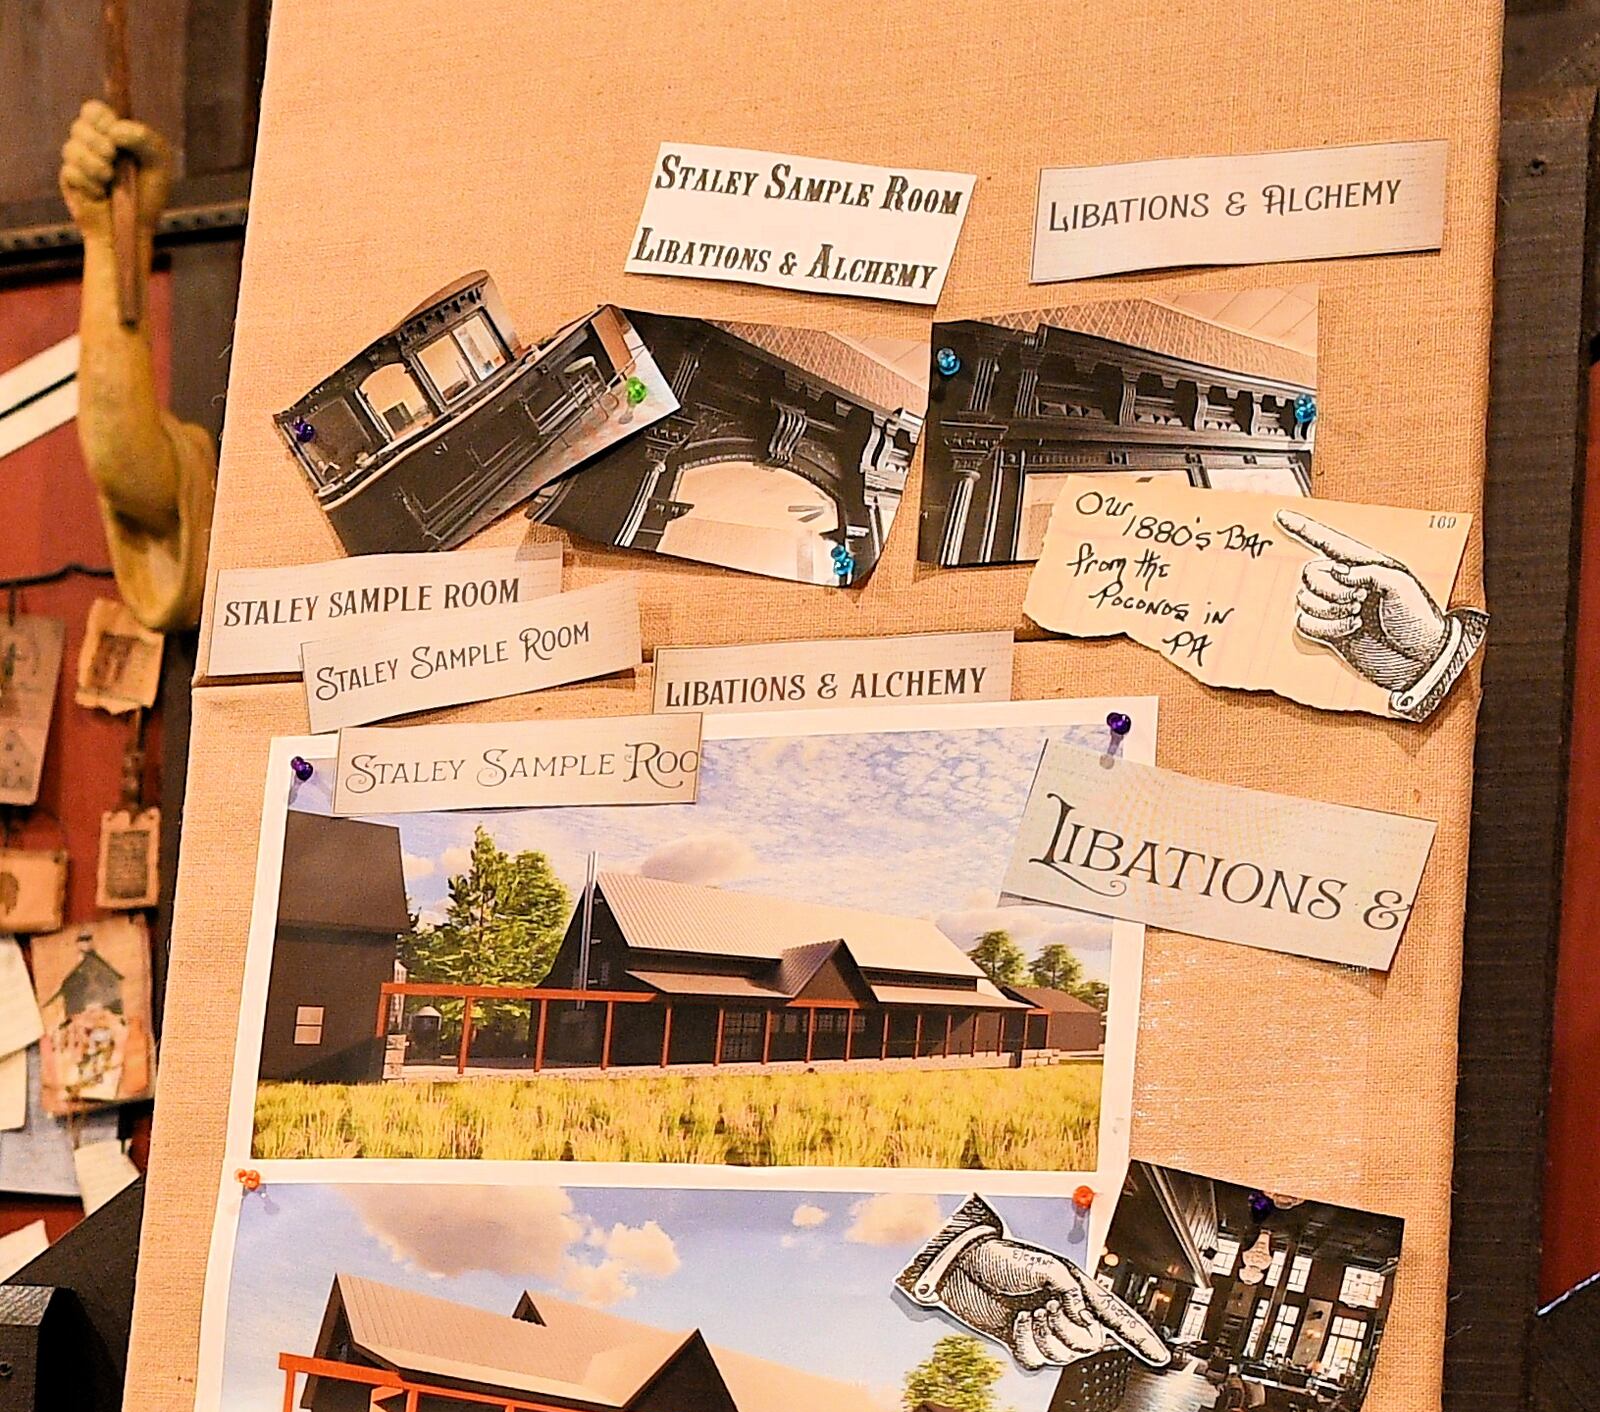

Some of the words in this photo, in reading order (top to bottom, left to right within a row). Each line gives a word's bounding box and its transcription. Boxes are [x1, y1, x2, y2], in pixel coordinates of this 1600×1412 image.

[654, 153, 760, 197] STALEY
[763, 162, 875, 208] SAMPLE
[879, 174, 964, 216] ROOM
[1048, 192, 1210, 233] LIBATIONS
[1225, 190, 1246, 217] &
[1261, 178, 1403, 217] ALCHEMY
[631, 227, 772, 274] LIBATIONS
[778, 250, 797, 276] &
[804, 242, 939, 290] ALCHEMY
[1076, 491, 1134, 519] Our
[1123, 514, 1212, 551] 1880's
[1066, 542, 1128, 580] from
[1133, 548, 1170, 591] the
[223, 595, 319, 628] STALEY
[328, 584, 433, 619] SAMPLE
[443, 577, 521, 610] ROOM
[315, 657, 399, 702] STALEY
[410, 639, 509, 680] SAMPLE
[518, 621, 591, 663] ROOM
[1161, 631, 1213, 668] PA
[665, 674, 807, 708] LIBATIONS
[816, 672, 839, 701] &
[849, 666, 988, 700] ALCHEMY
[344, 752, 466, 796] STALEY
[475, 747, 616, 788] SAMPLE
[1028, 792, 1349, 921] LIBATIONS
[1363, 889, 1412, 932] &
